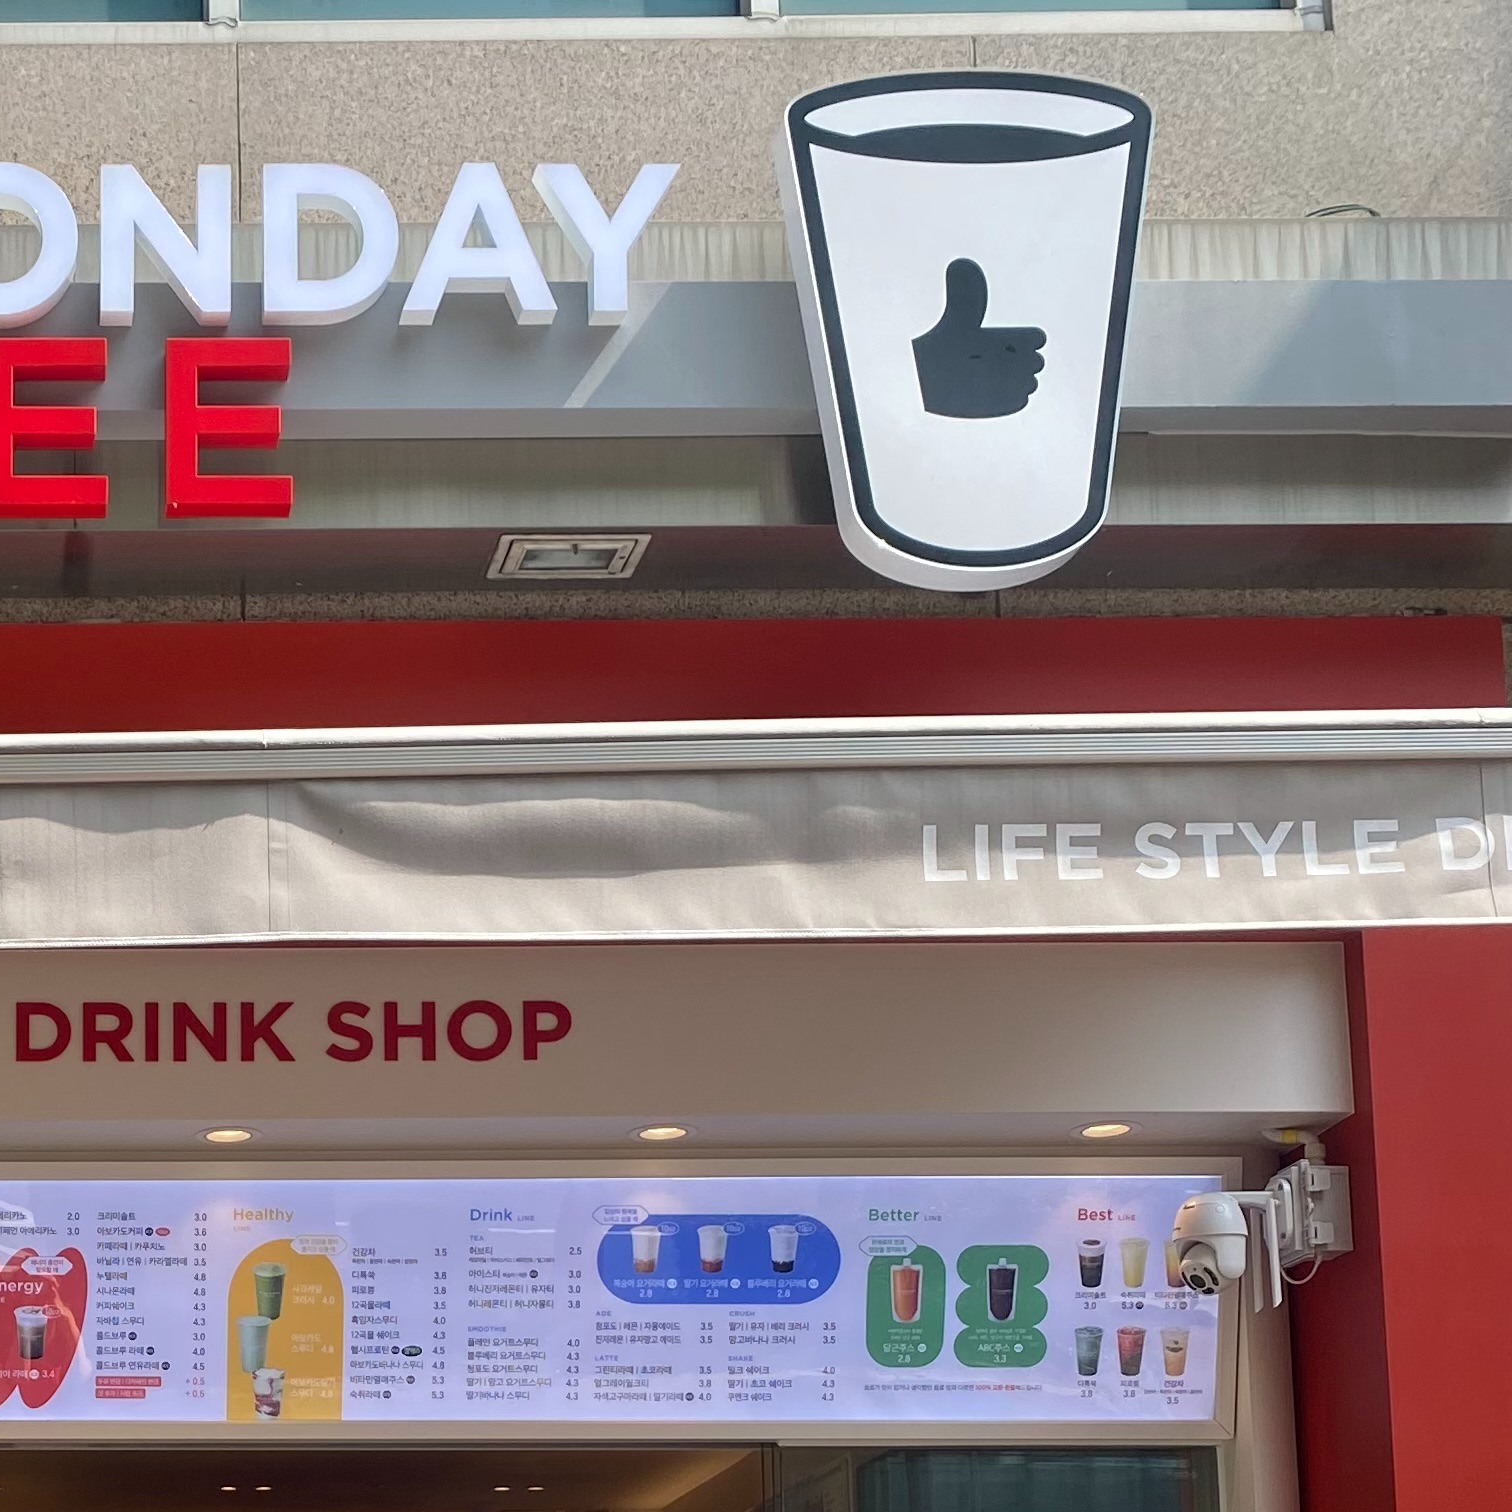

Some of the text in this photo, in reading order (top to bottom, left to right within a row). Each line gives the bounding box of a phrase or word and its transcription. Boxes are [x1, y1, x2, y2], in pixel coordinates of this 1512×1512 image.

[922, 815, 1512, 882] LIFE STYLE D
[14, 1001, 295, 1063] DRINK
[324, 1000, 572, 1062] SHOP
[67, 1212, 80, 1221] 2.0
[97, 1212, 207, 1221] 크리미솔트 3.0
[234, 1208, 294, 1223] Healthy
[470, 1209, 513, 1221] Drink
[868, 1209, 920, 1222] Better
[1078, 1208, 1114, 1221] Best
[67, 1227, 80, 1236] 3.0
[97, 1227, 143, 1236] 아보카도커피
[97, 1242, 207, 1252] 카페라떼 카푸치노 3.0
[469, 1246, 582, 1255] 허브티 2.5
[352, 1247, 448, 1257] 건강차 3.5
[194, 1258, 207, 1267] 3.5
[434, 1271, 447, 1280] 3.8
[468, 1269, 500, 1278] 아이스티
[568, 1270, 581, 1279] 3.0
[97, 1286, 135, 1296] 시나몬라떼
[433, 1286, 447, 1295] 3.8
[468, 1284, 581, 1294] 허니진저레몬티 유자티 3.0
[193, 1303, 206, 1311] 4.3
[433, 1301, 447, 1310] 3.5
[468, 1300, 581, 1309] 허니레몬티 허니자몽티 3.8
[1084, 1302, 1097, 1310] 3.0
[1121, 1302, 1134, 1310] 5.3
[121, 1317, 145, 1325] 스무디
[193, 1318, 206, 1326] 4.3
[432, 1317, 446, 1325] 4.0
[700, 1322, 713, 1331] 3.5
[823, 1322, 836, 1331] 3.5
[96, 1331, 206, 1341] 콜드브루 3.0
[432, 1331, 446, 1340] 4.3
[700, 1336, 713, 1344] 3.5
[823, 1336, 836, 1344] 3.5
[492, 1338, 539, 1347] 요거트스무디
[567, 1339, 580, 1347] 4.0
[96, 1346, 206, 1356] 콜드브루 라떼 4.0
[432, 1346, 445, 1354] 4.5
[467, 1351, 580, 1361] 블루베리 요거트스무디 4.3
[993, 1354, 1007, 1363] 3.3
[96, 1361, 127, 1370] 콜드브루
[193, 1362, 205, 1371] 4.5
[402, 1360, 424, 1369] 스무디
[492, 1364, 538, 1373] 요거트스무디
[566, 1366, 579, 1374] 4.3
[42, 1370, 55, 1379] 3.4
[699, 1366, 712, 1375] 3.5
[506, 1378, 552, 1387] 요거트스무디
[566, 1379, 579, 1387] 4.3
[698, 1379, 712, 1388] 3.8
[750, 1379, 835, 1388] 초코 4.3
[431, 1391, 445, 1399] 5.3
[506, 1391, 579, 1401] 스무디 4.3
[698, 1393, 712, 1401] 4.0
[821, 1393, 835, 1401] 4.3
[1167, 1397, 1179, 1405] 3.5
